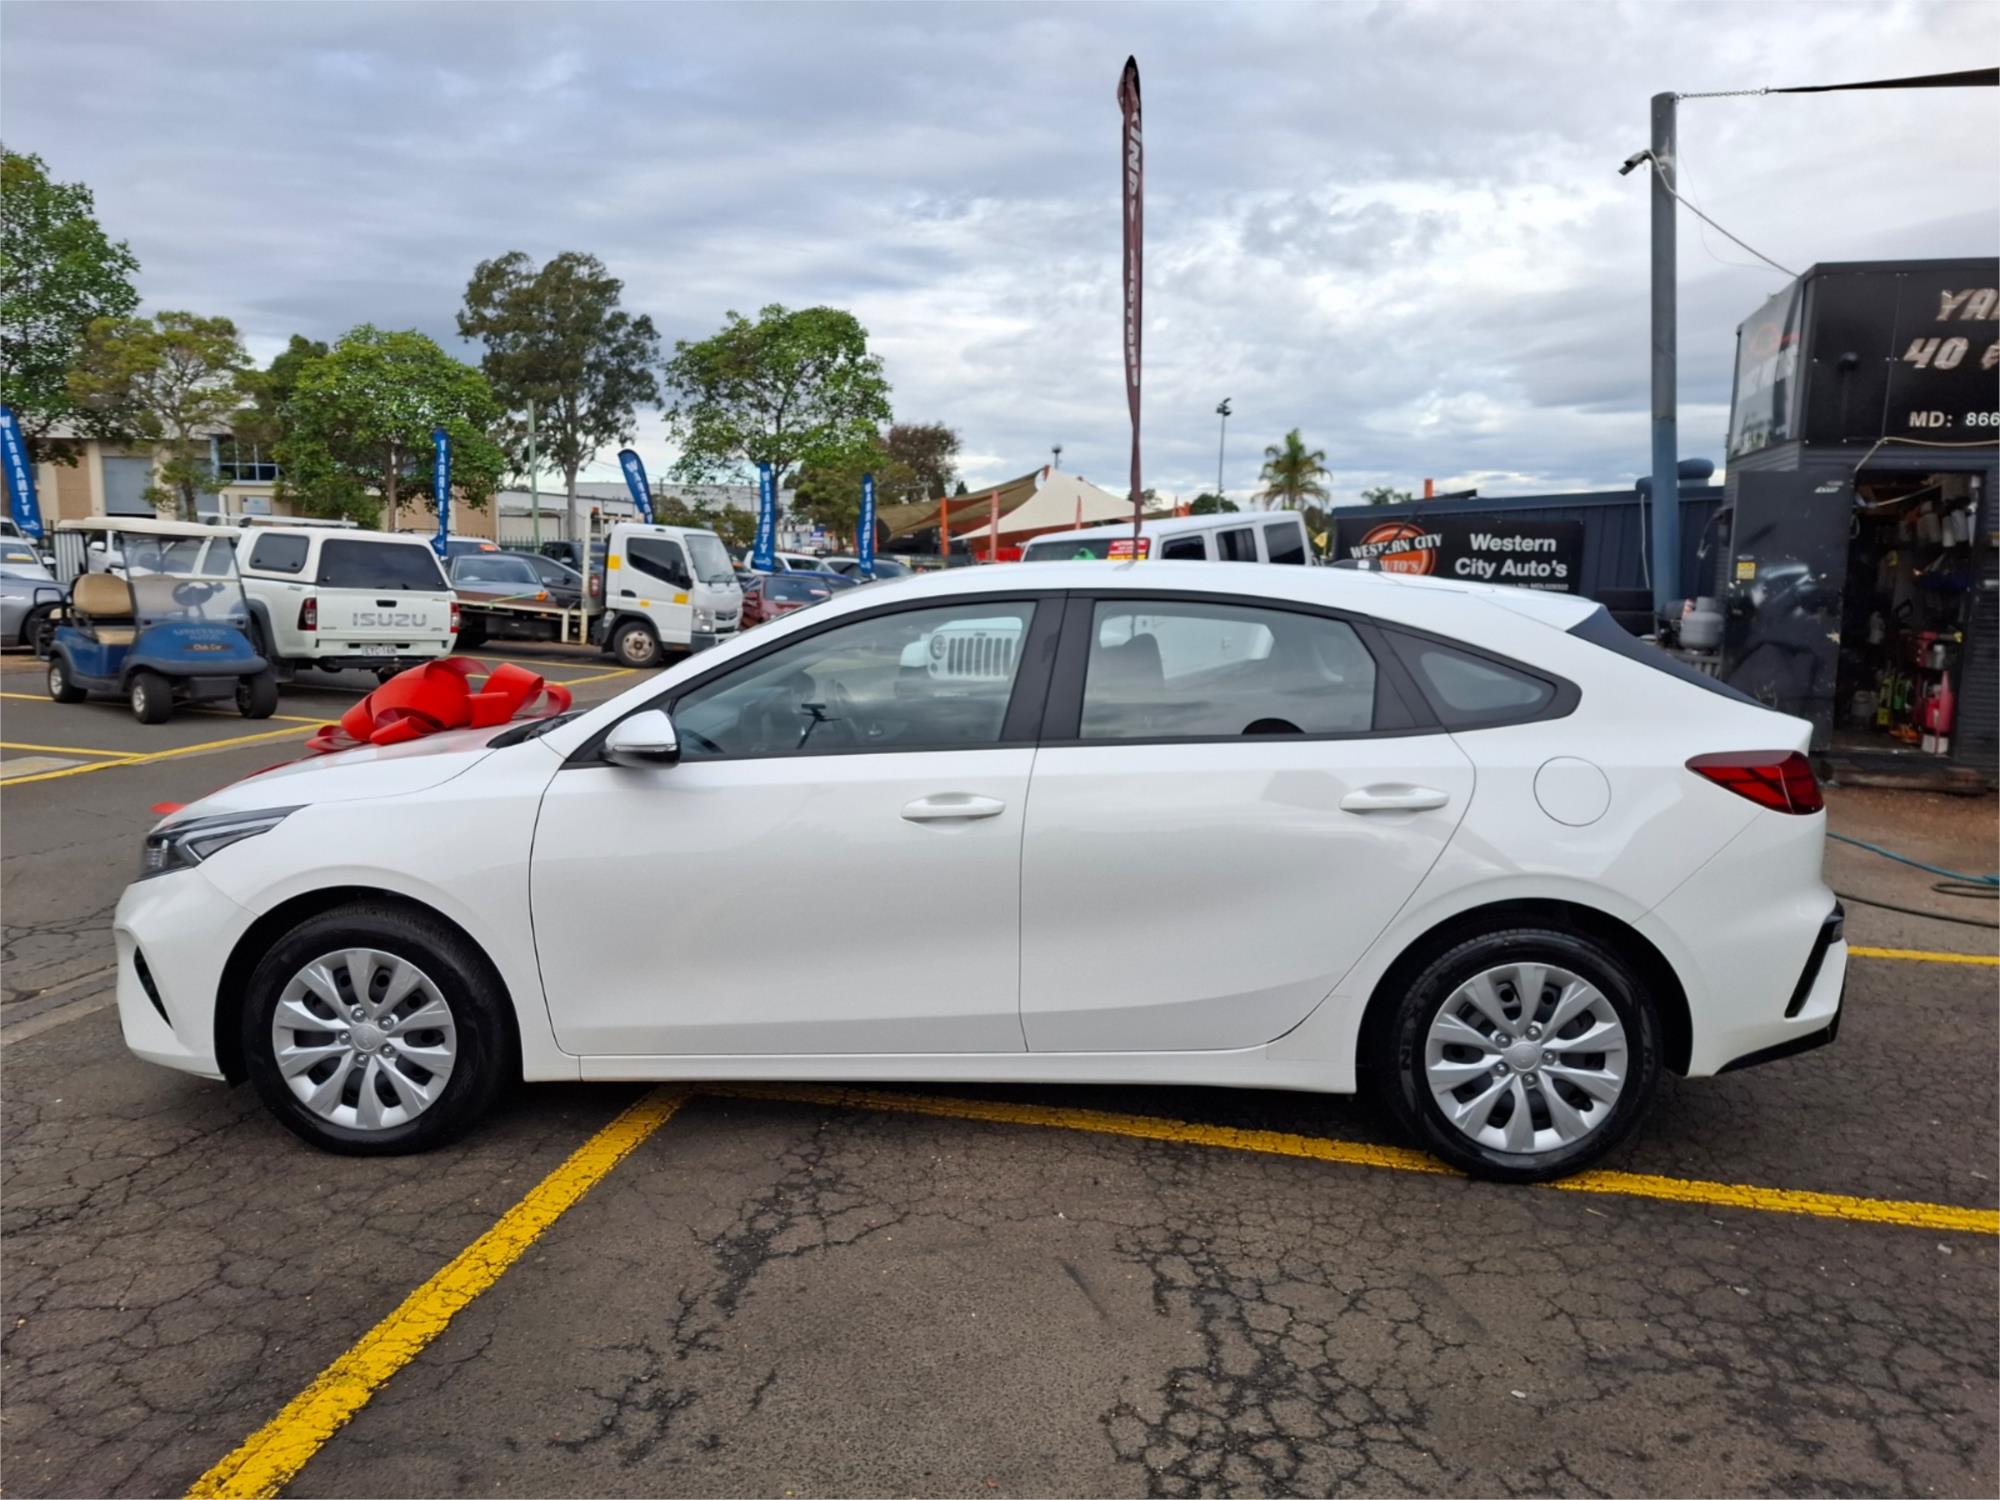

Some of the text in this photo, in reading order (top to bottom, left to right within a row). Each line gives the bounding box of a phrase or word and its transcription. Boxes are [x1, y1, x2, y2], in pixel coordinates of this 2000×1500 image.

[1903, 336, 1969, 370] 40
[1909, 411, 1952, 428] MD:
[0, 415, 30, 516] WARRANTY
[761, 470, 771, 554] WARRANTY
[1414, 533, 1442, 549] CITY
[1469, 533, 1557, 552] Western
[1455, 557, 1568, 579] City Auto's
[352, 612, 427, 628] ISUZU
